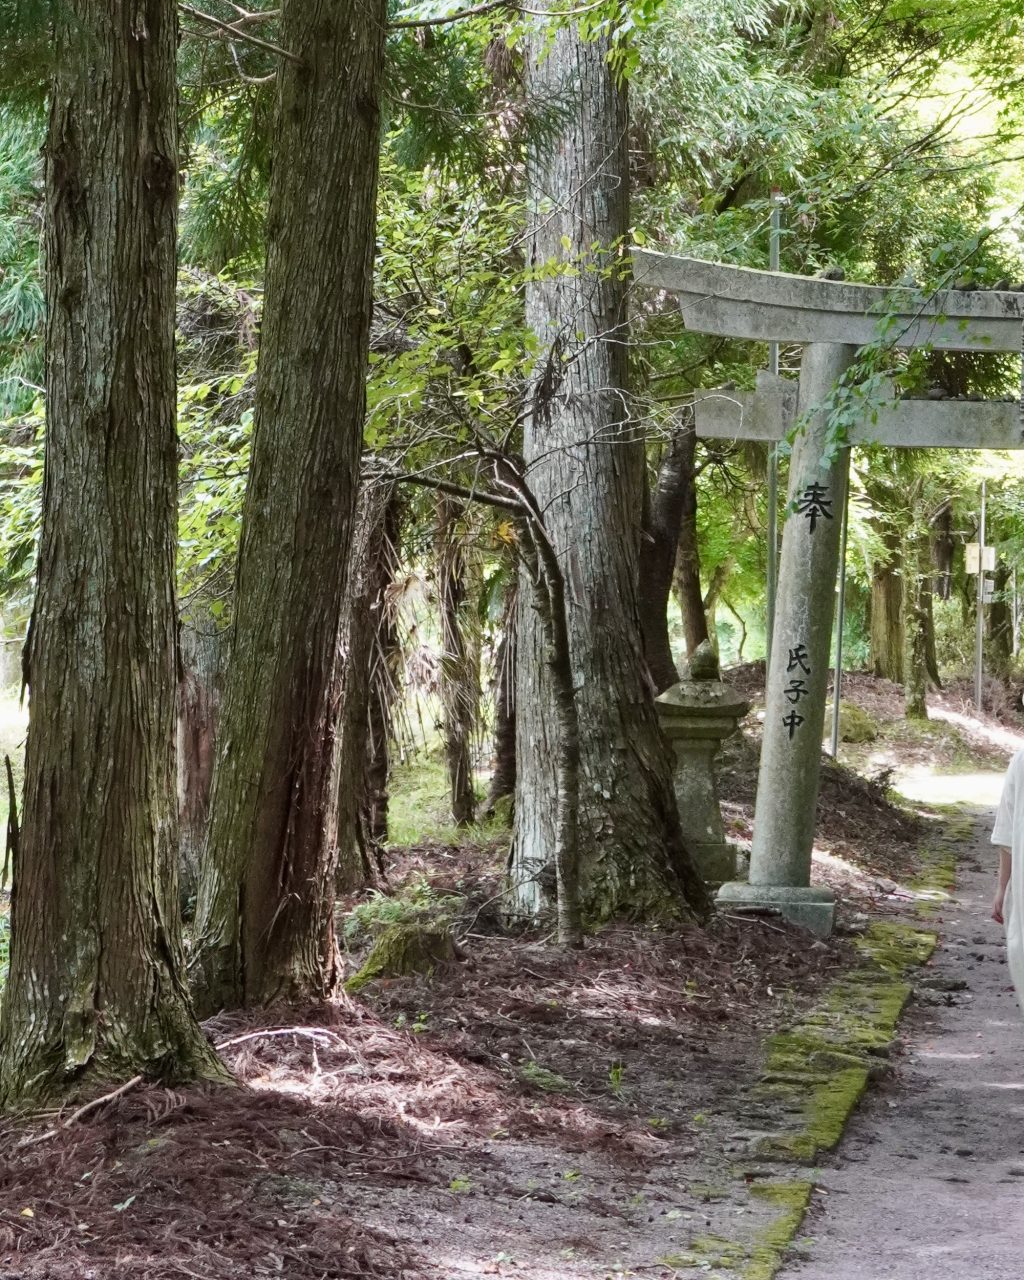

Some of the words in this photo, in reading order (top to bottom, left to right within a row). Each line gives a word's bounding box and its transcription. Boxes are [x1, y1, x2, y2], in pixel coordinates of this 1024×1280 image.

[798, 481, 833, 535] 奉
[782, 644, 811, 740] 氏子中
